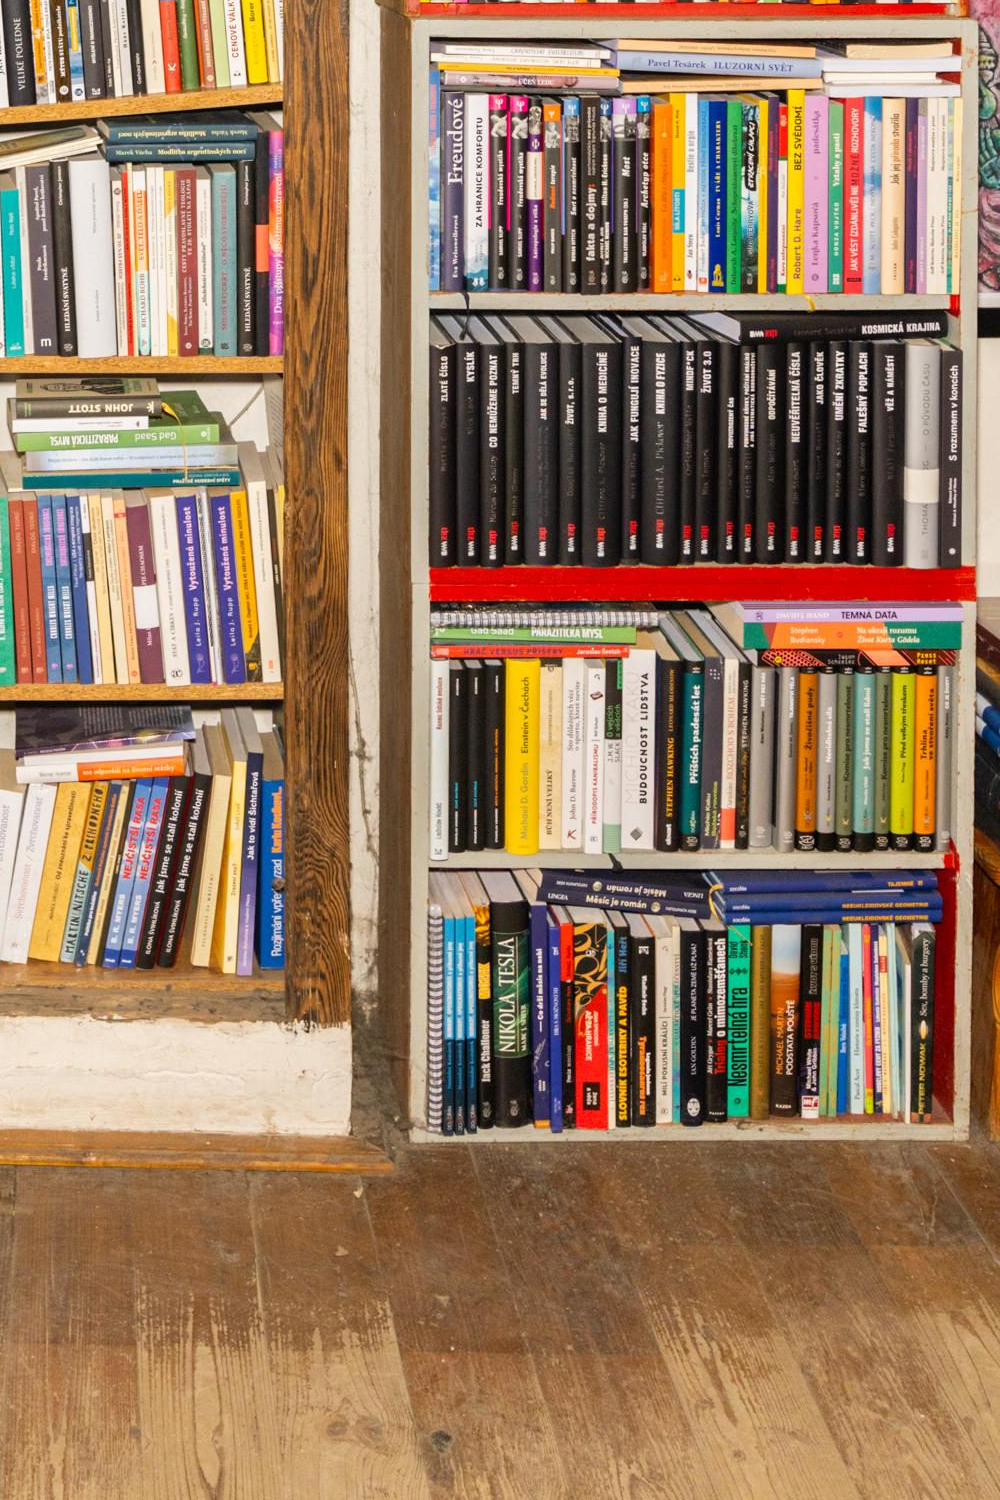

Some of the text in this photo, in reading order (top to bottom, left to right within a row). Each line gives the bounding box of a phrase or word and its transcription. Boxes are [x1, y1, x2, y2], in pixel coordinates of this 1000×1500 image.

[648, 59, 795, 72] Pavel Tesárek ILUZORNÍ SVĚT
[446, 99, 463, 186] Freudové
[476, 215, 482, 227] ZA
[862, 321, 941, 334] KOSMICKÁ KRAJINA
[700, 351, 712, 393] ŽIVOT 3.0
[68, 403, 134, 413] JOHN STOTT
[183, 506, 199, 591] Vytoužená minulost
[841, 611, 898, 619] TEMNÁ DATA
[639, 673, 648, 804] BUDOUCNOST LIDSTVA
[689, 685, 701, 784] Příštích padesát let
[121, 797, 146, 880] NEJČISTŠÍ RASA
[497, 938, 516, 1052] NIKOLA TESLA
[713, 938, 728, 1074] Trialog o mimozemšťanech
[619, 1018, 628, 1026] A
[727, 987, 748, 1087] Nesmrtelná hra
[618, 1028, 628, 1077] ESOTERIKY
[617, 1079, 628, 1121] SLOVNÍK
